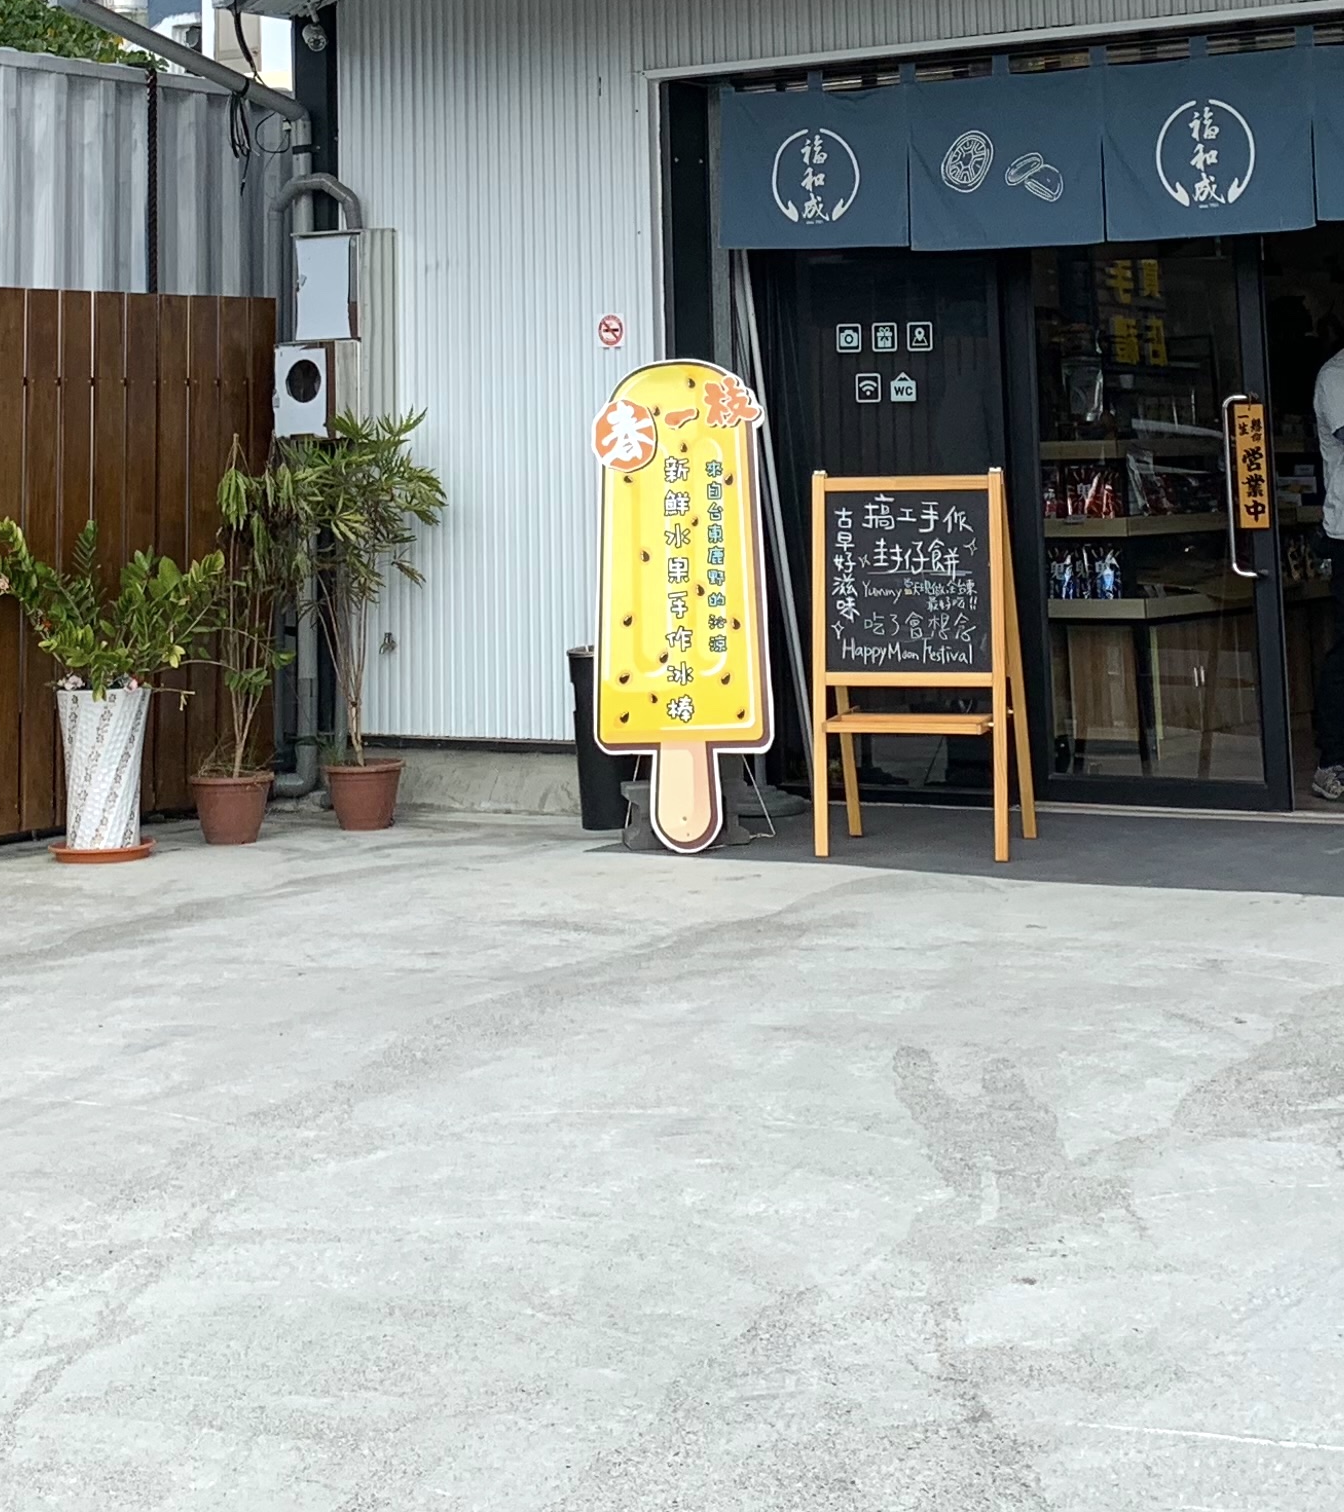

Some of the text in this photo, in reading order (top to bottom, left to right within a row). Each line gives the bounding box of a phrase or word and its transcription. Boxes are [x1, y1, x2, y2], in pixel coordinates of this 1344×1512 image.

[893, 386, 914, 397] WC
[600, 377, 759, 464] 春一枝
[832, 507, 859, 623] 古早好滋味
[664, 456, 695, 723] 新鮮水果手作冰棒
[862, 581, 902, 604] Yummy
[864, 612, 976, 641] 吃了會想念
[922, 637, 973, 664] Festival
